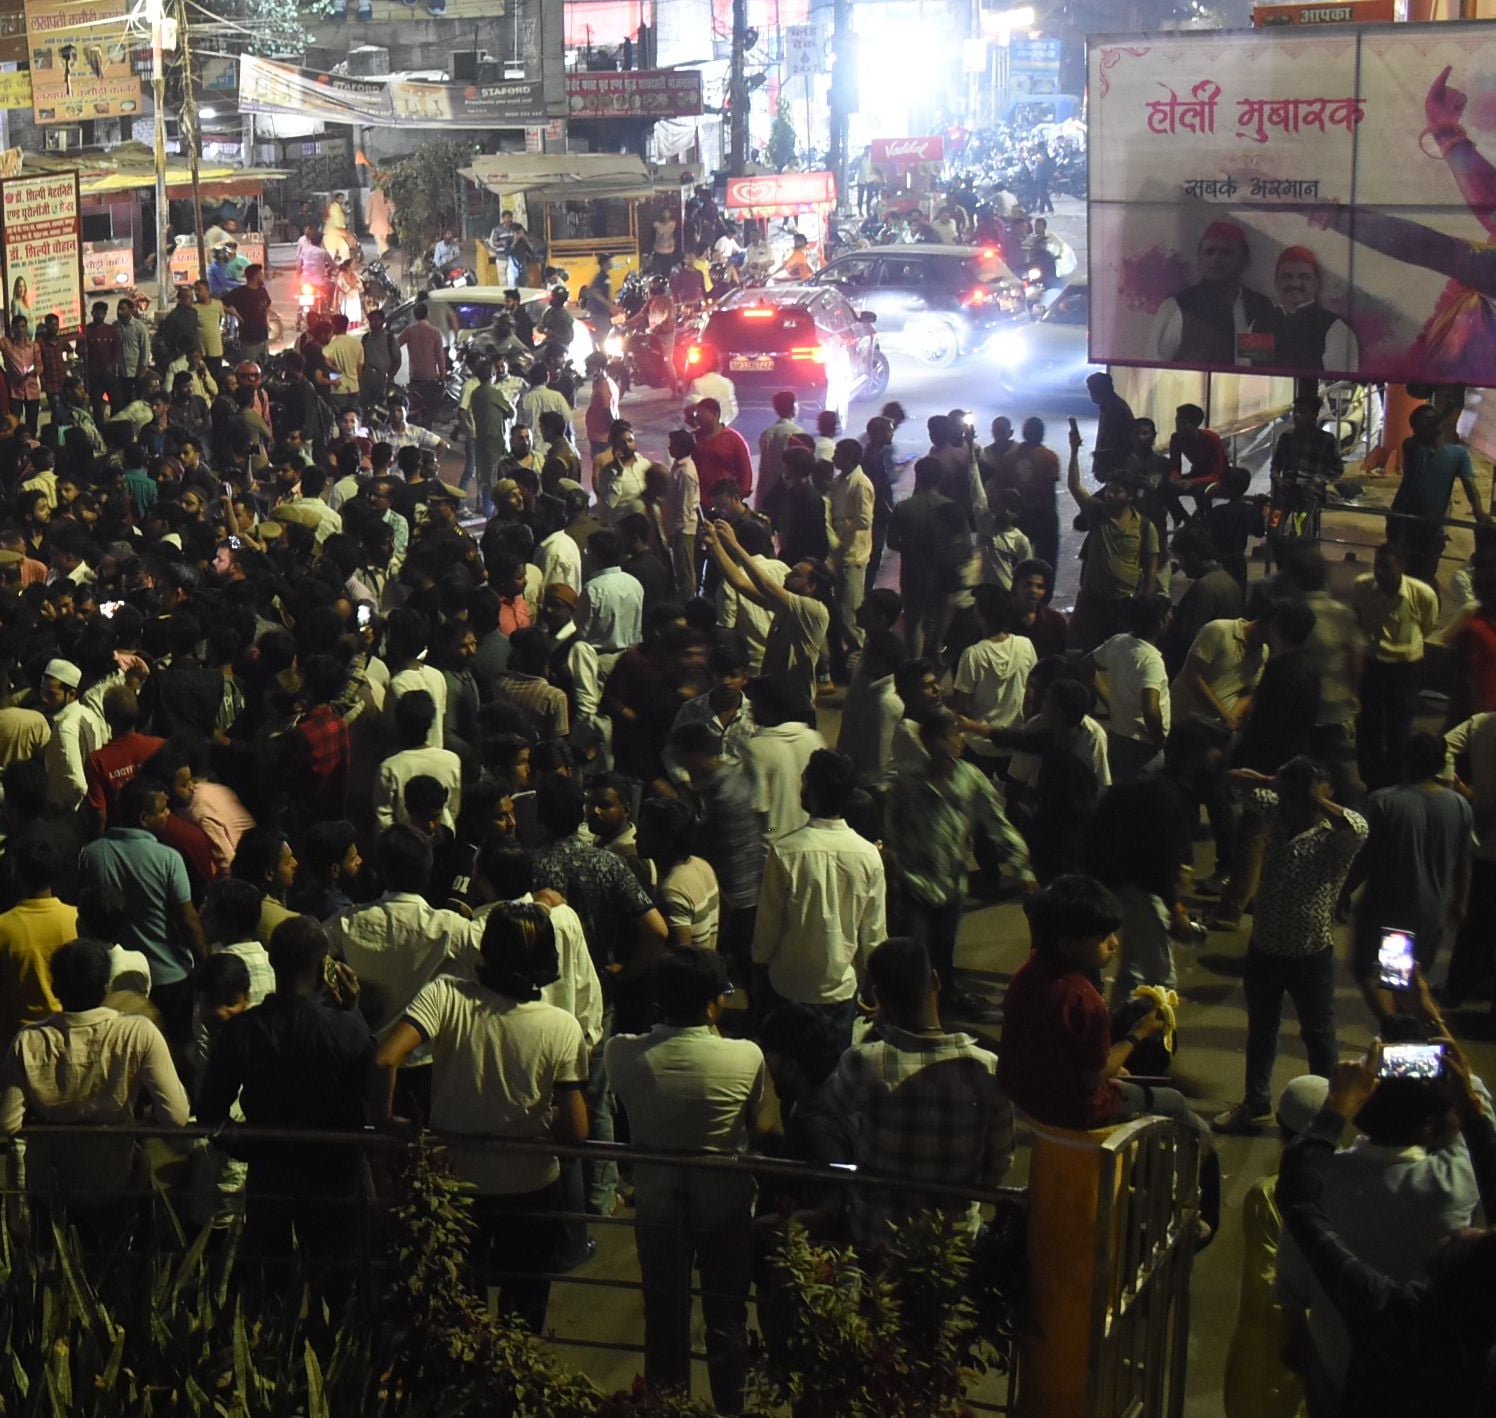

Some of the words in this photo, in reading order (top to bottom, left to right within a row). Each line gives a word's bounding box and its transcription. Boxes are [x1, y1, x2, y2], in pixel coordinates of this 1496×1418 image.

[1301, 7, 1352, 22] आपका
[1145, 79, 1222, 135] होली
[1235, 97, 1367, 143] मुबारक
[26, 184, 47, 201] शिल्पी
[1184, 175, 1237, 199] सबके
[1250, 179, 1320, 199] अरमान
[6, 209, 21, 221] एण्ड
[10, 244, 23, 261] डॉ.
[25, 241, 51, 258] शिल्पी
